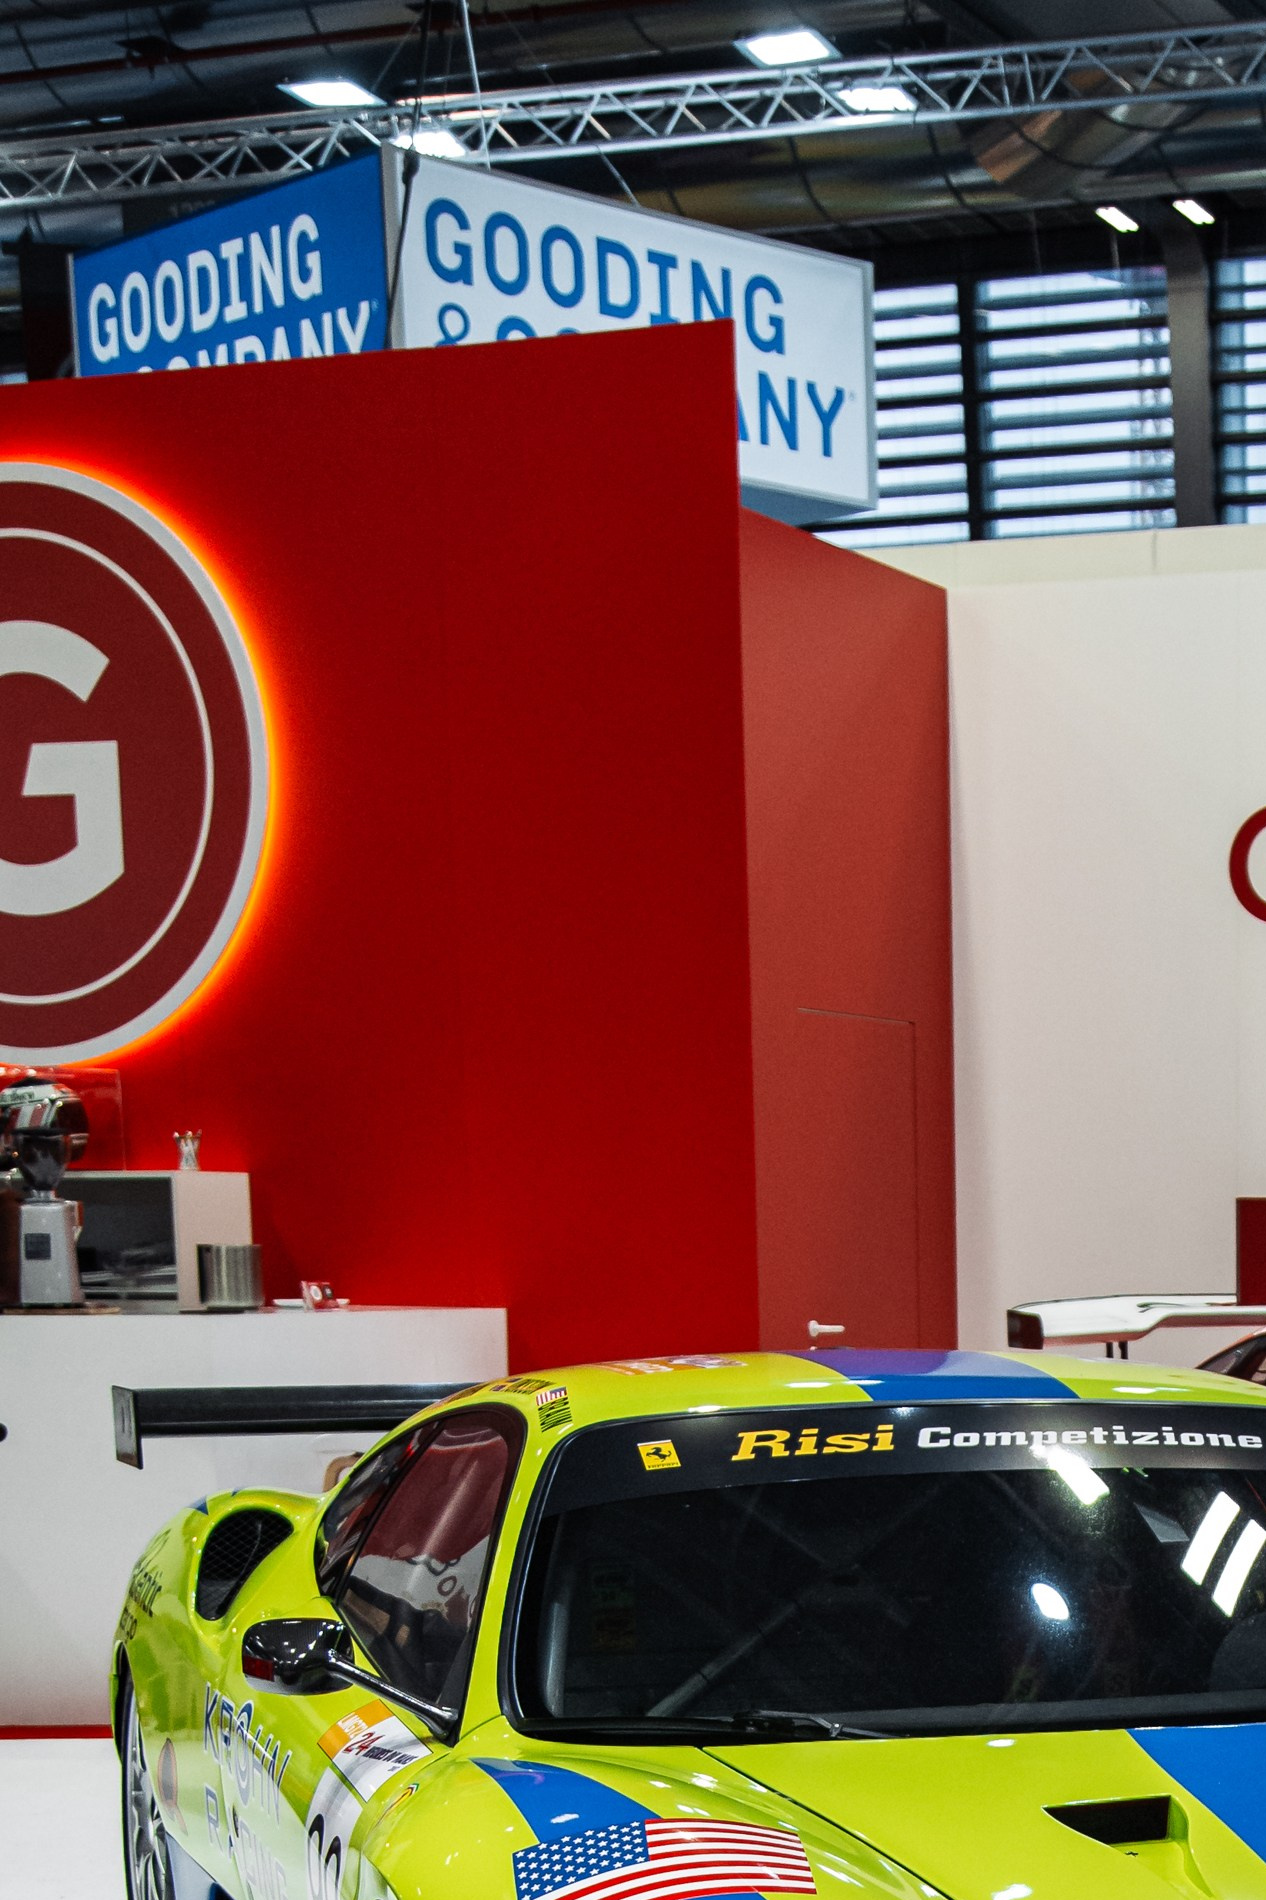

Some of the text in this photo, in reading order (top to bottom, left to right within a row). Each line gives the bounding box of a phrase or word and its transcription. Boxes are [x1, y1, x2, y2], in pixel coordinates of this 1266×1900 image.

[88, 213, 323, 364] GOODING
[425, 197, 786, 356] GOODING
[0, 619, 125, 917] G
[731, 1423, 1263, 1462] Risi Competizione
[203, 1682, 292, 1826] KROHN
